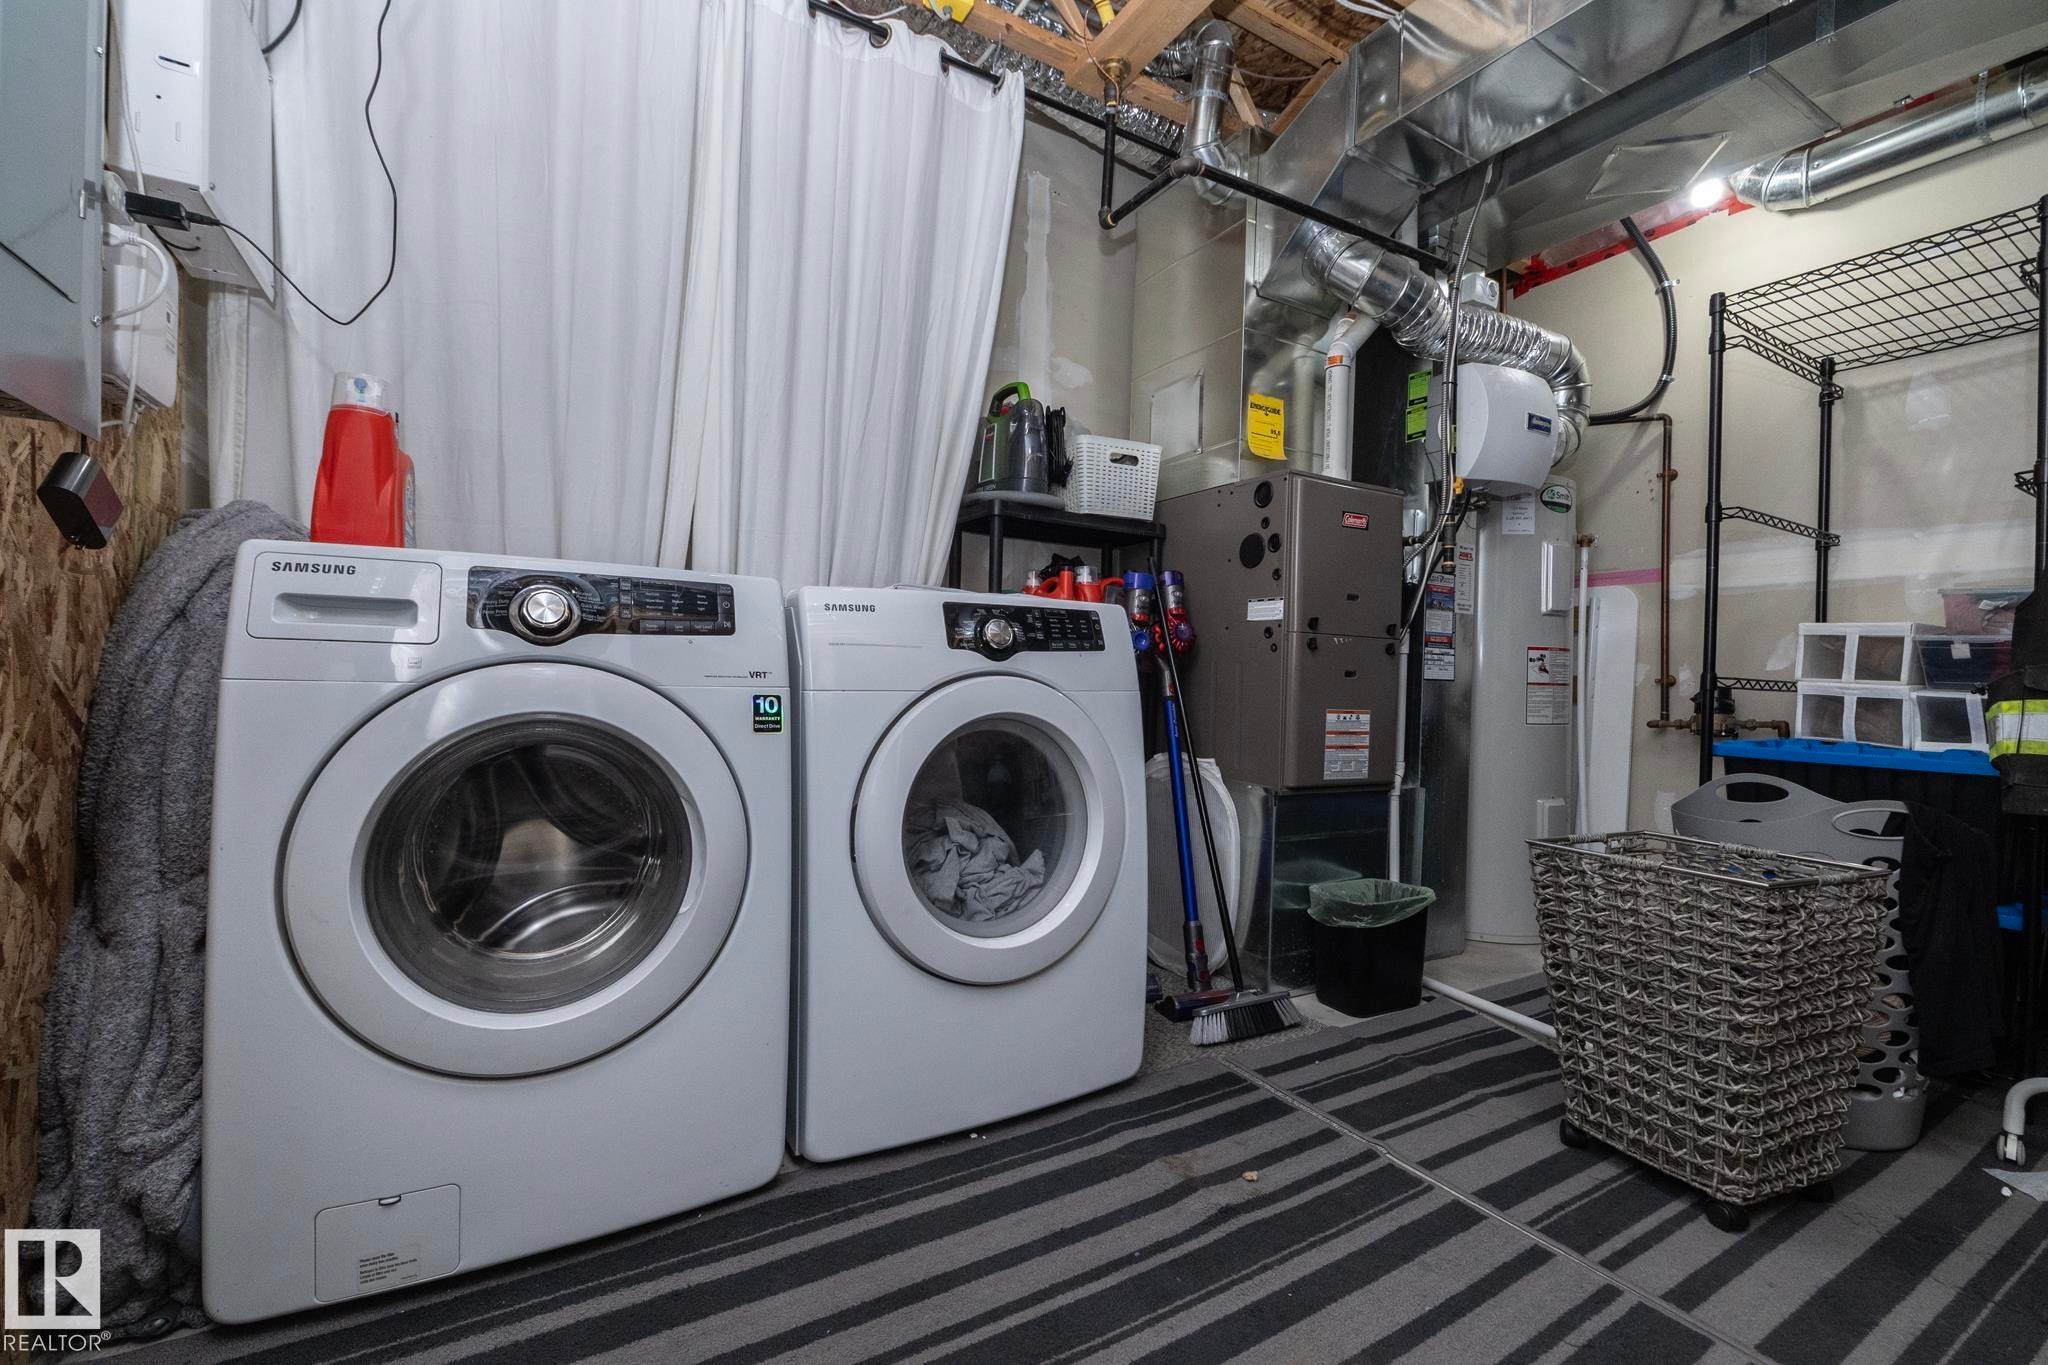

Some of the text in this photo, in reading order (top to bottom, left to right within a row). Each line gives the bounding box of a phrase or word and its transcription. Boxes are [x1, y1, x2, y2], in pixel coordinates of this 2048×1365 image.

[271, 561, 356, 575] SAMSUNG
[824, 602, 876, 613] SAMSUNG
[755, 697, 778, 714] 10
